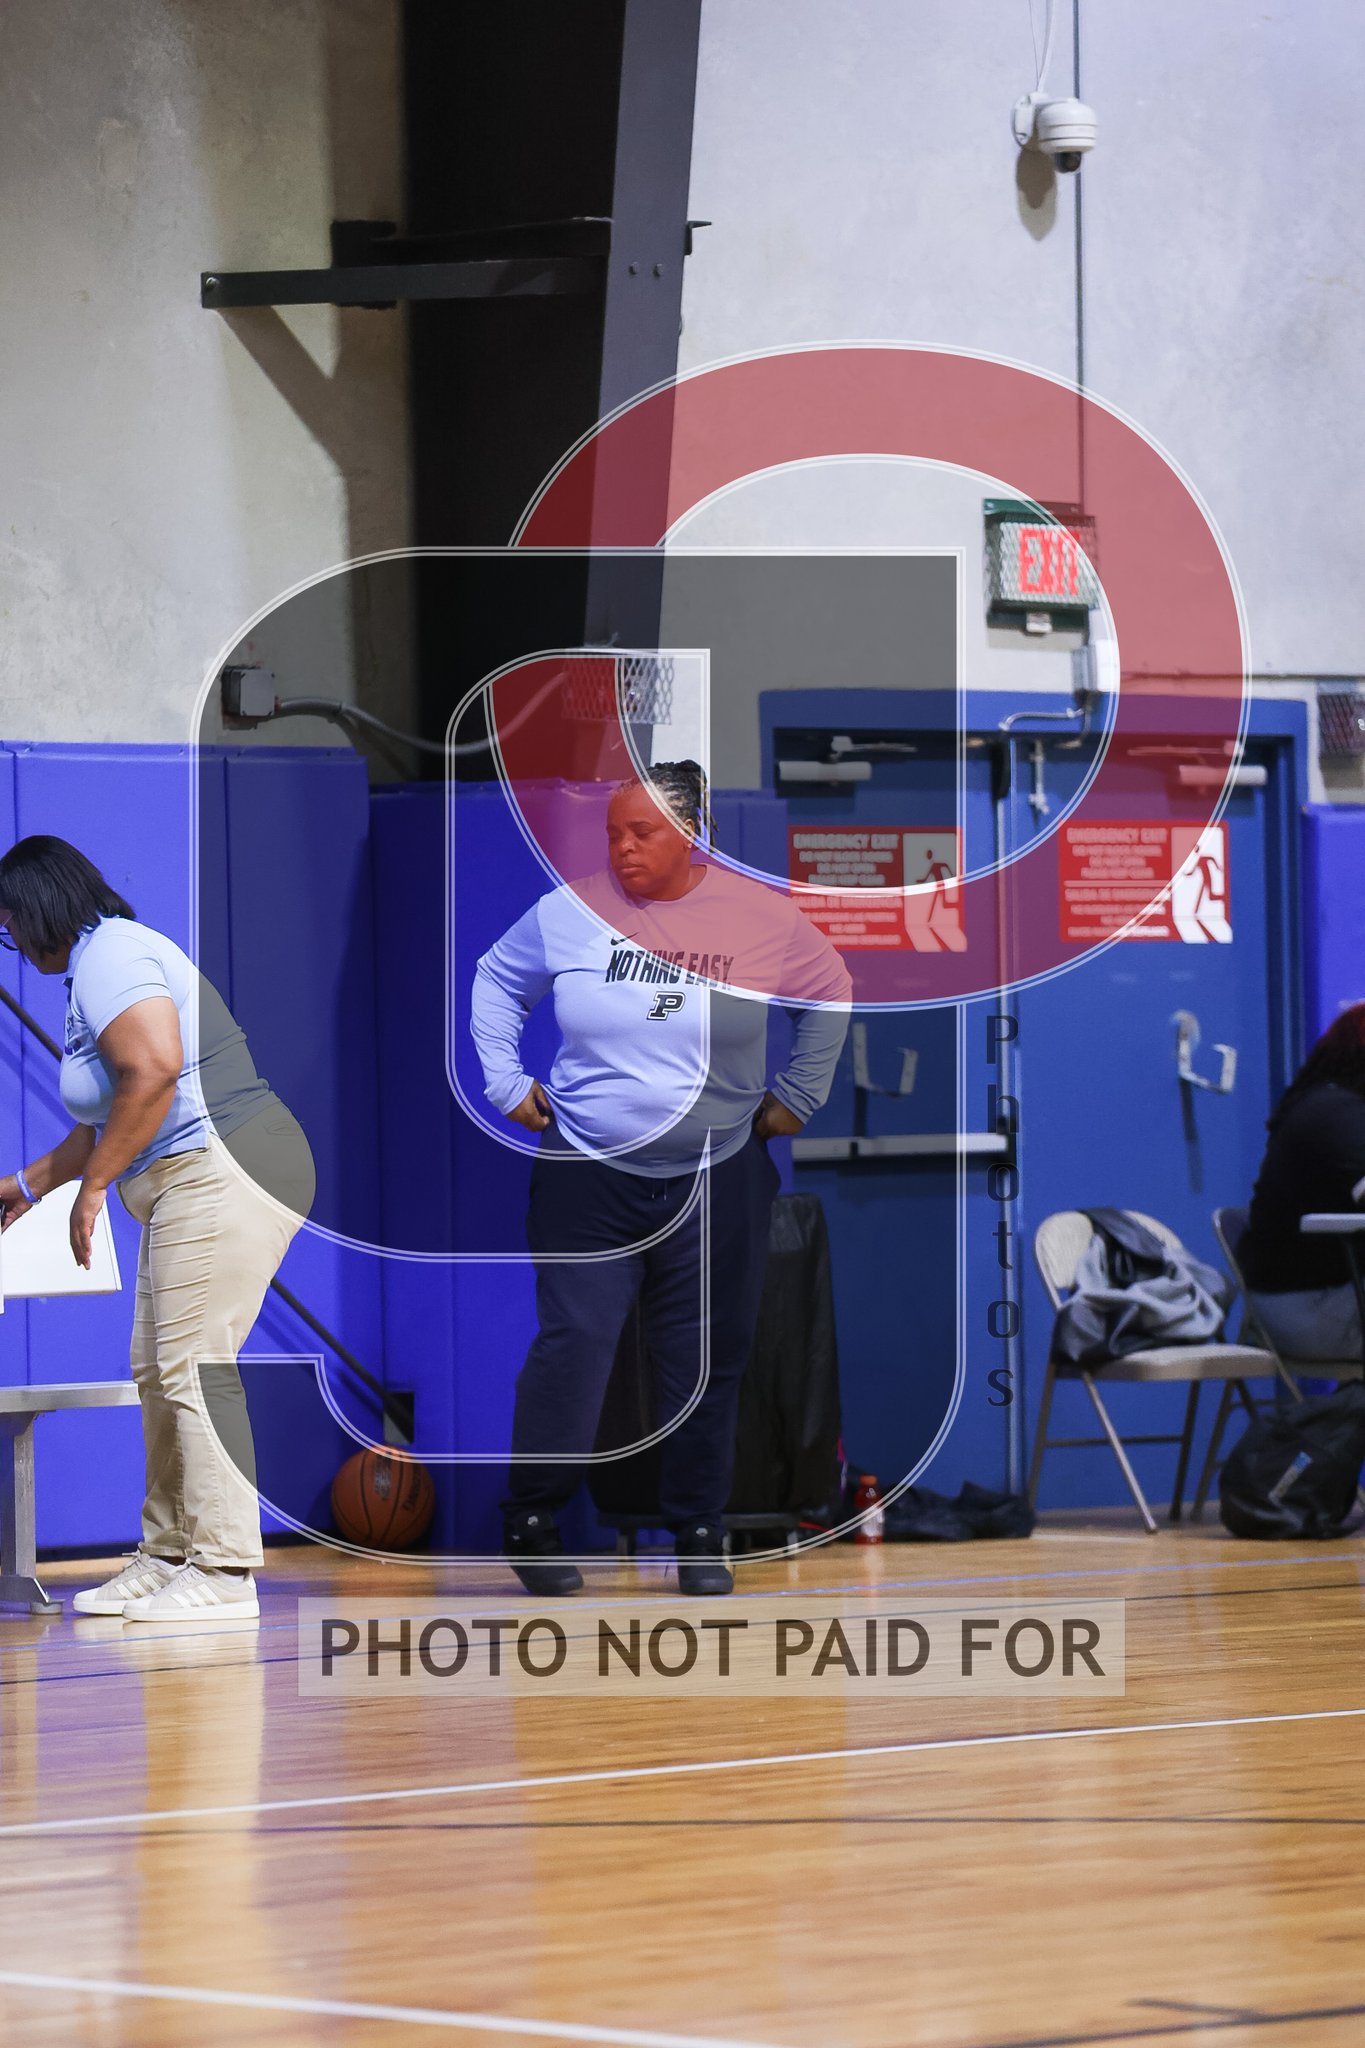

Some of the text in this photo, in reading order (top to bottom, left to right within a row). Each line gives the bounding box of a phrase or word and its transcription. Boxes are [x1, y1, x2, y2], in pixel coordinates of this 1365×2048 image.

[1018, 527, 1082, 596] EXIT
[870, 833, 899, 849] EXIT
[605, 950, 685, 984] NOTHING
[646, 990, 687, 1021] P
